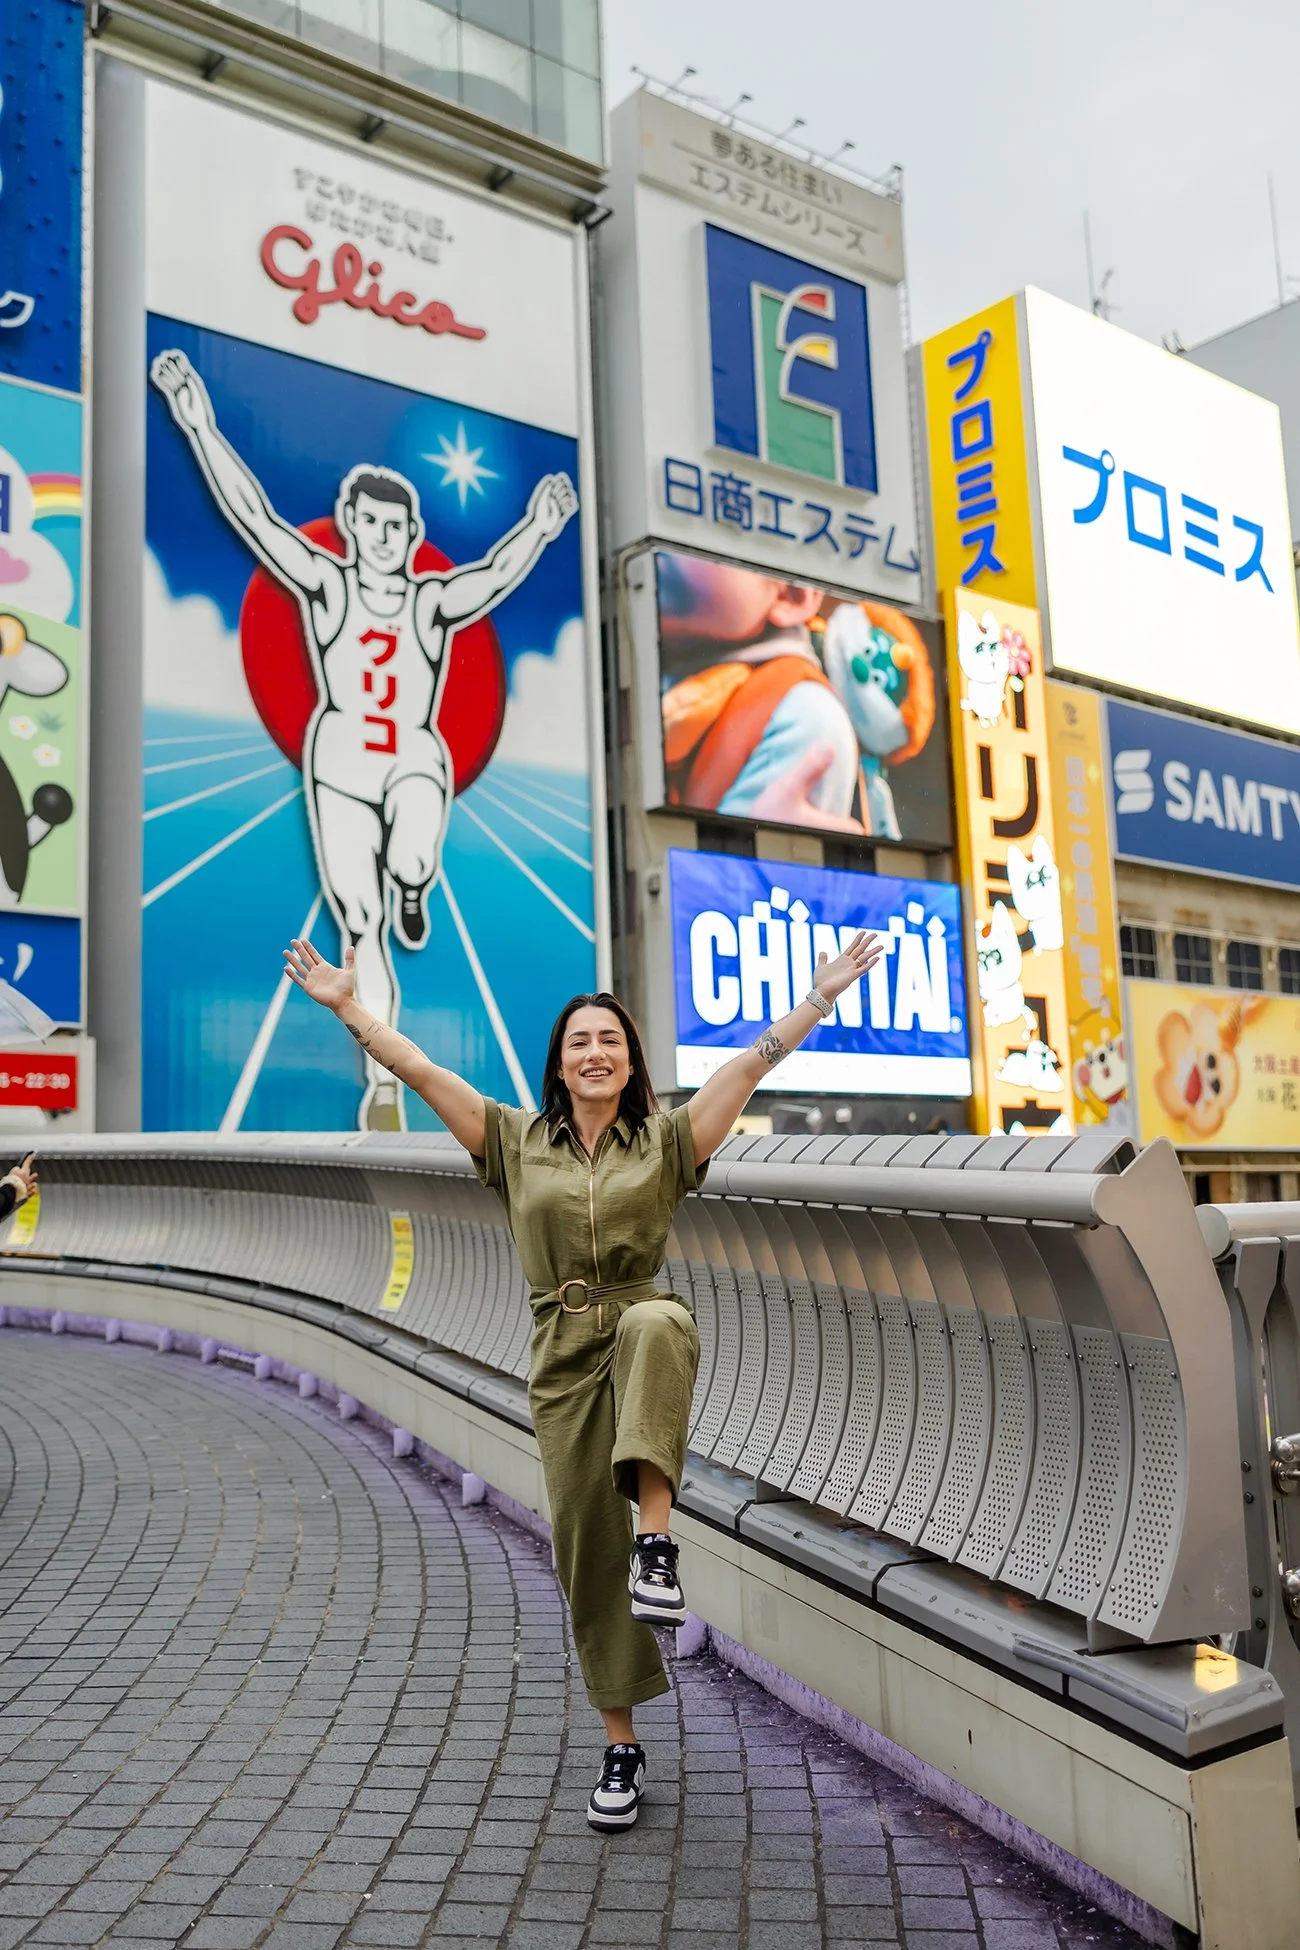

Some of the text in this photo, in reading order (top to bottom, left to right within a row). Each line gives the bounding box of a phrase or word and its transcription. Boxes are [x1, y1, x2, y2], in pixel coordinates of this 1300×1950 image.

[260, 224, 487, 341] Glico
[664, 456, 921, 574] 日商エステム
[946, 329, 1004, 586] プロミス
[1062, 444, 1275, 595] プロミス
[358, 625, 402, 756] グリコ
